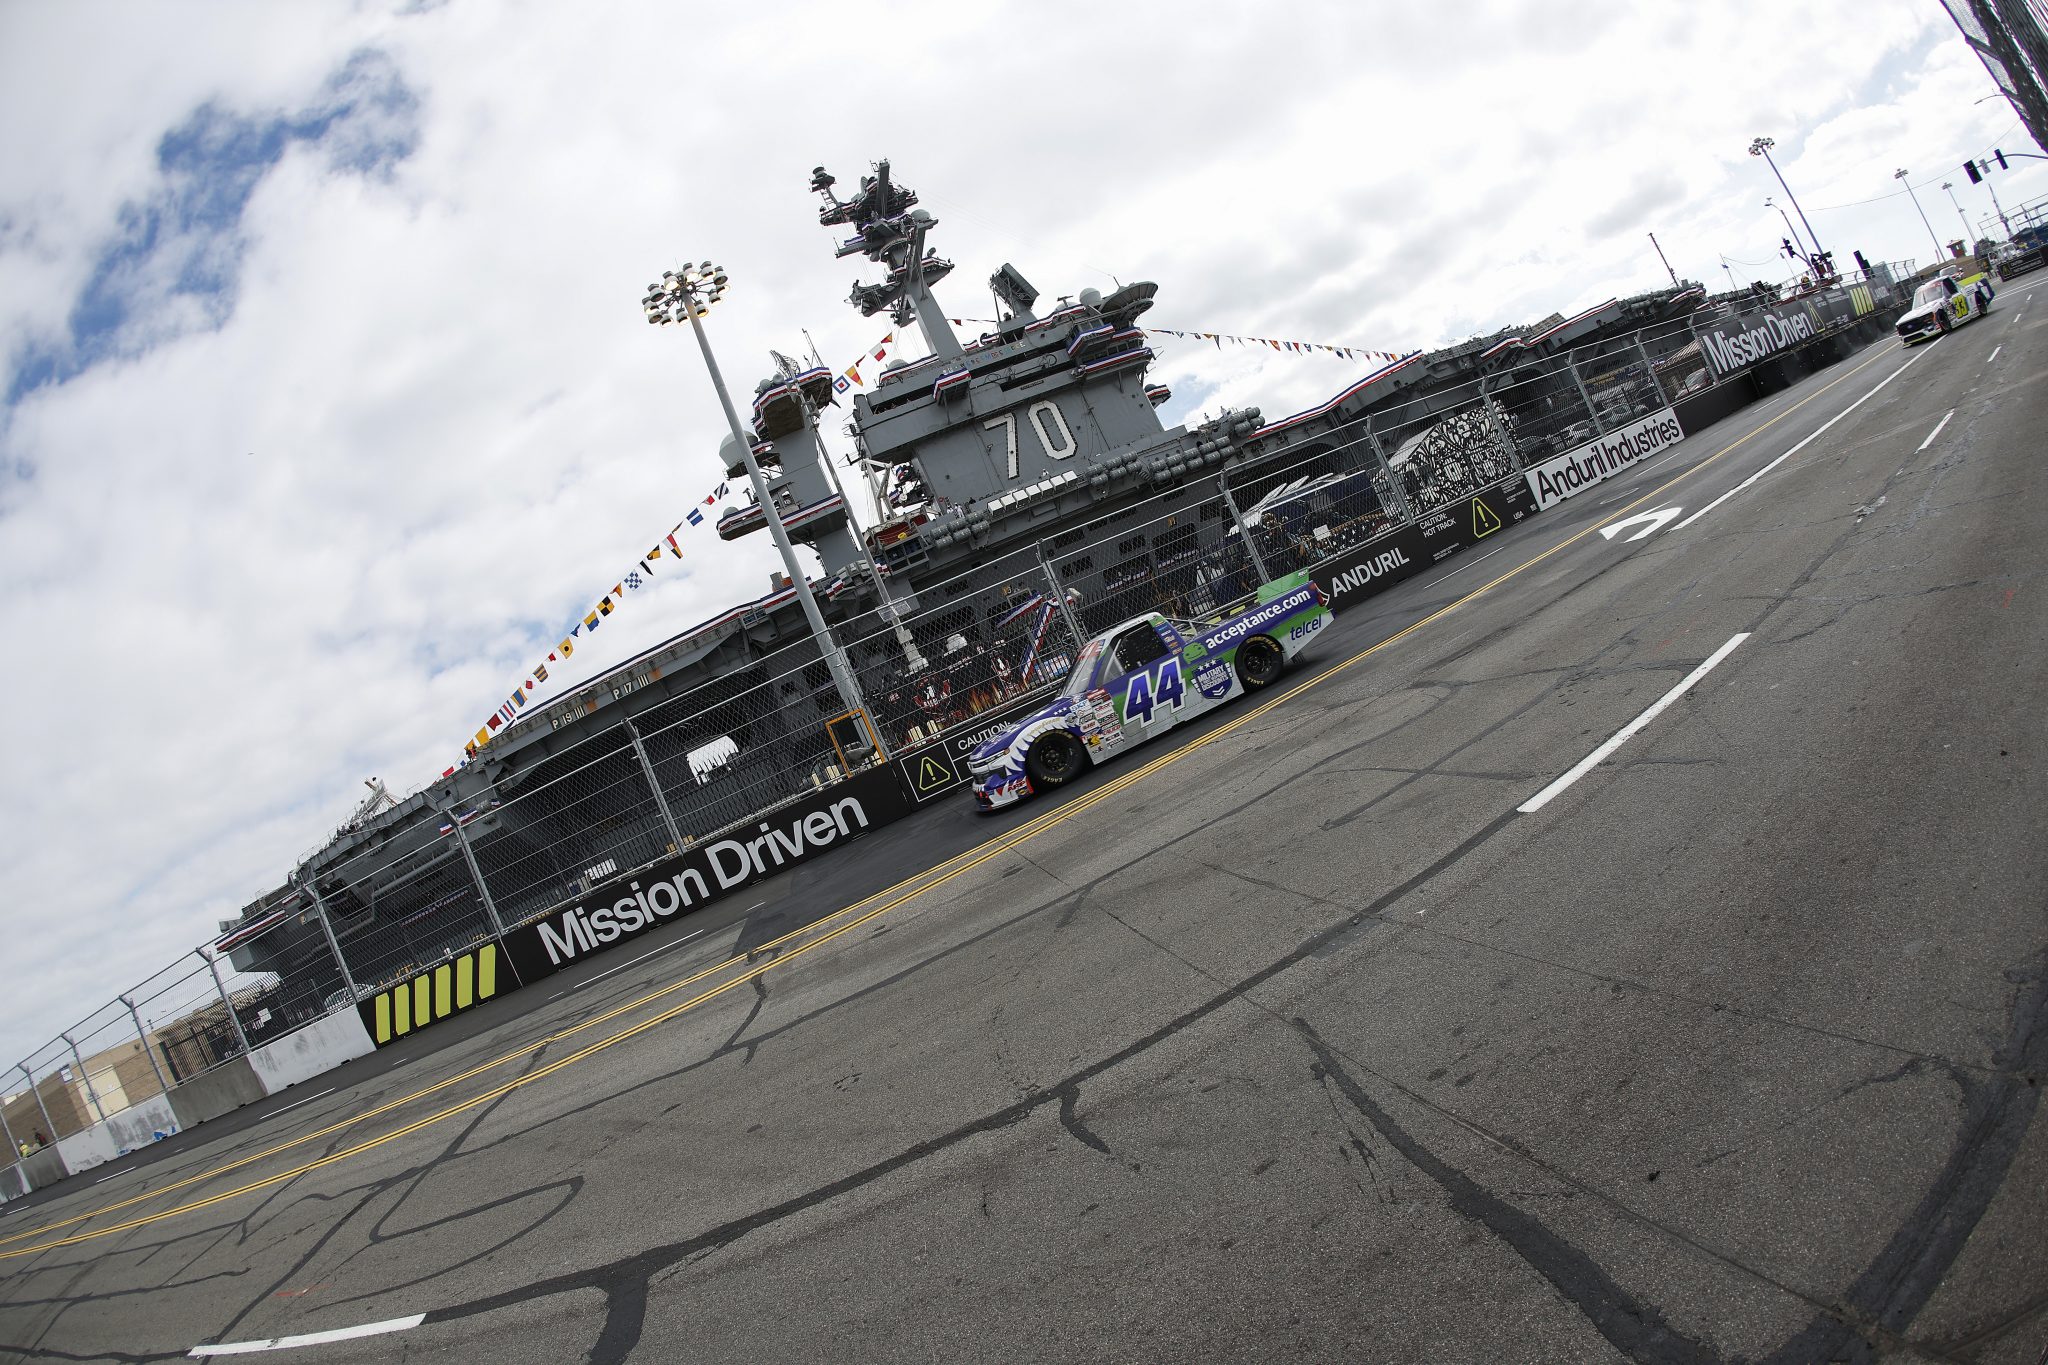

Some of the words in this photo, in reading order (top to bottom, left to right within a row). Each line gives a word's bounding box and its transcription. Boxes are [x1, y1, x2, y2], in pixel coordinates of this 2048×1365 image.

[1703, 324, 1775, 374] Mission
[1764, 311, 1814, 349] Driven
[982, 400, 1080, 480] 70
[1537, 445, 1607, 503] Anduril
[1601, 418, 1679, 470] Industries
[1420, 513, 1447, 529] CAUTION:
[1423, 527, 1436, 538] HOT
[1436, 517, 1456, 531] TRACK
[1332, 547, 1410, 597] ANDURIL
[1205, 590, 1311, 649] acceptance.com
[1290, 614, 1322, 640] telcel
[613, 688, 620, 700] P
[623, 682, 632, 694] 17
[1123, 656, 1187, 728] 44
[1197, 665, 1225, 682] MILITARY
[552, 719, 559, 729] P
[562, 712, 573, 724] 19
[537, 868, 709, 965] Mission
[705, 796, 869, 890] Driven
